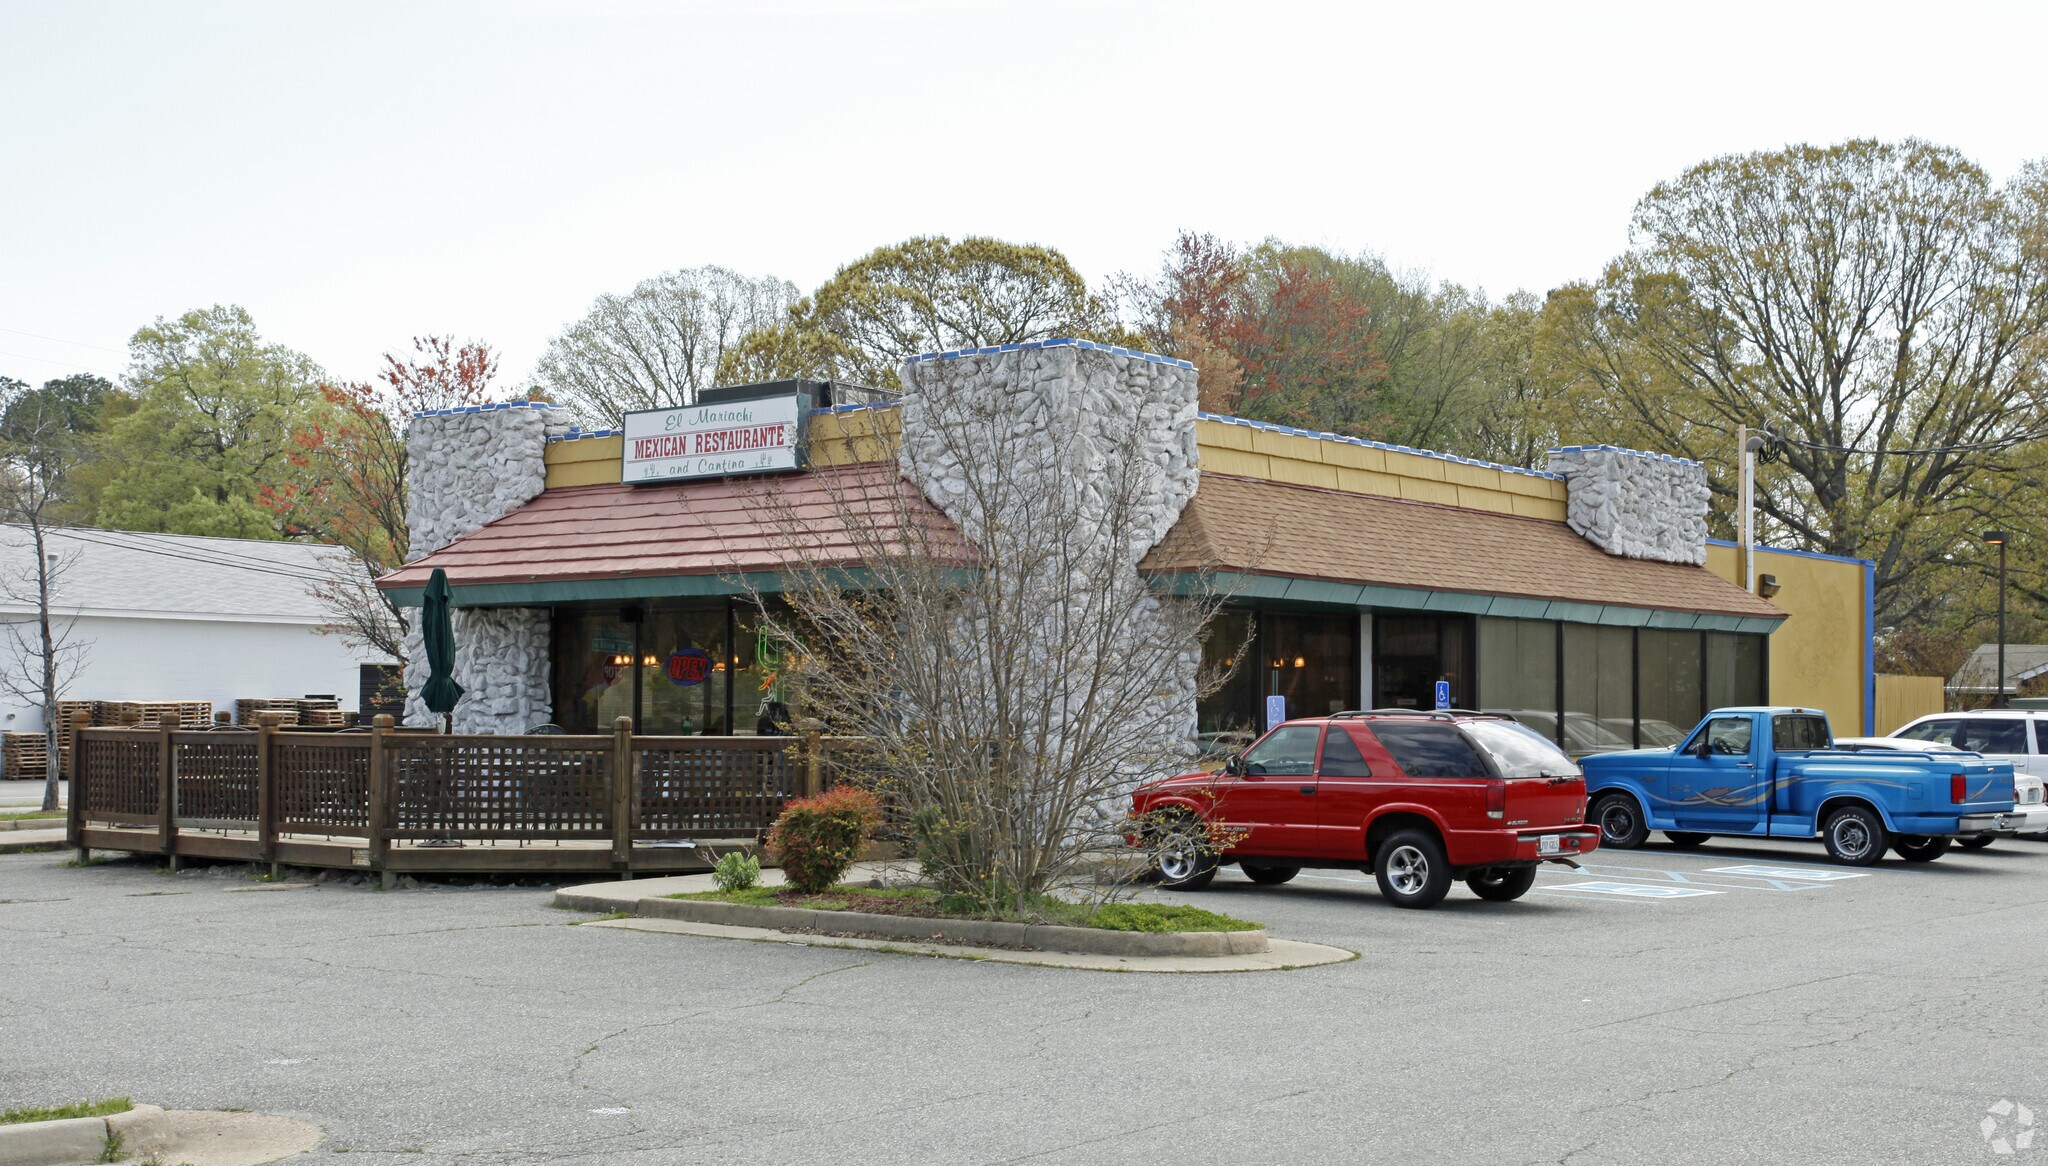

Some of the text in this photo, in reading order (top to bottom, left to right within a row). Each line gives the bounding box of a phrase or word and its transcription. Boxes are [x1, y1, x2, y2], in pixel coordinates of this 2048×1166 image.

[665, 407, 753, 431] El Mariachi
[635, 425, 785, 459] MEXICAN RESTAURANTE
[669, 458, 745, 474] and Cantina
[669, 655, 707, 681] OPEN
